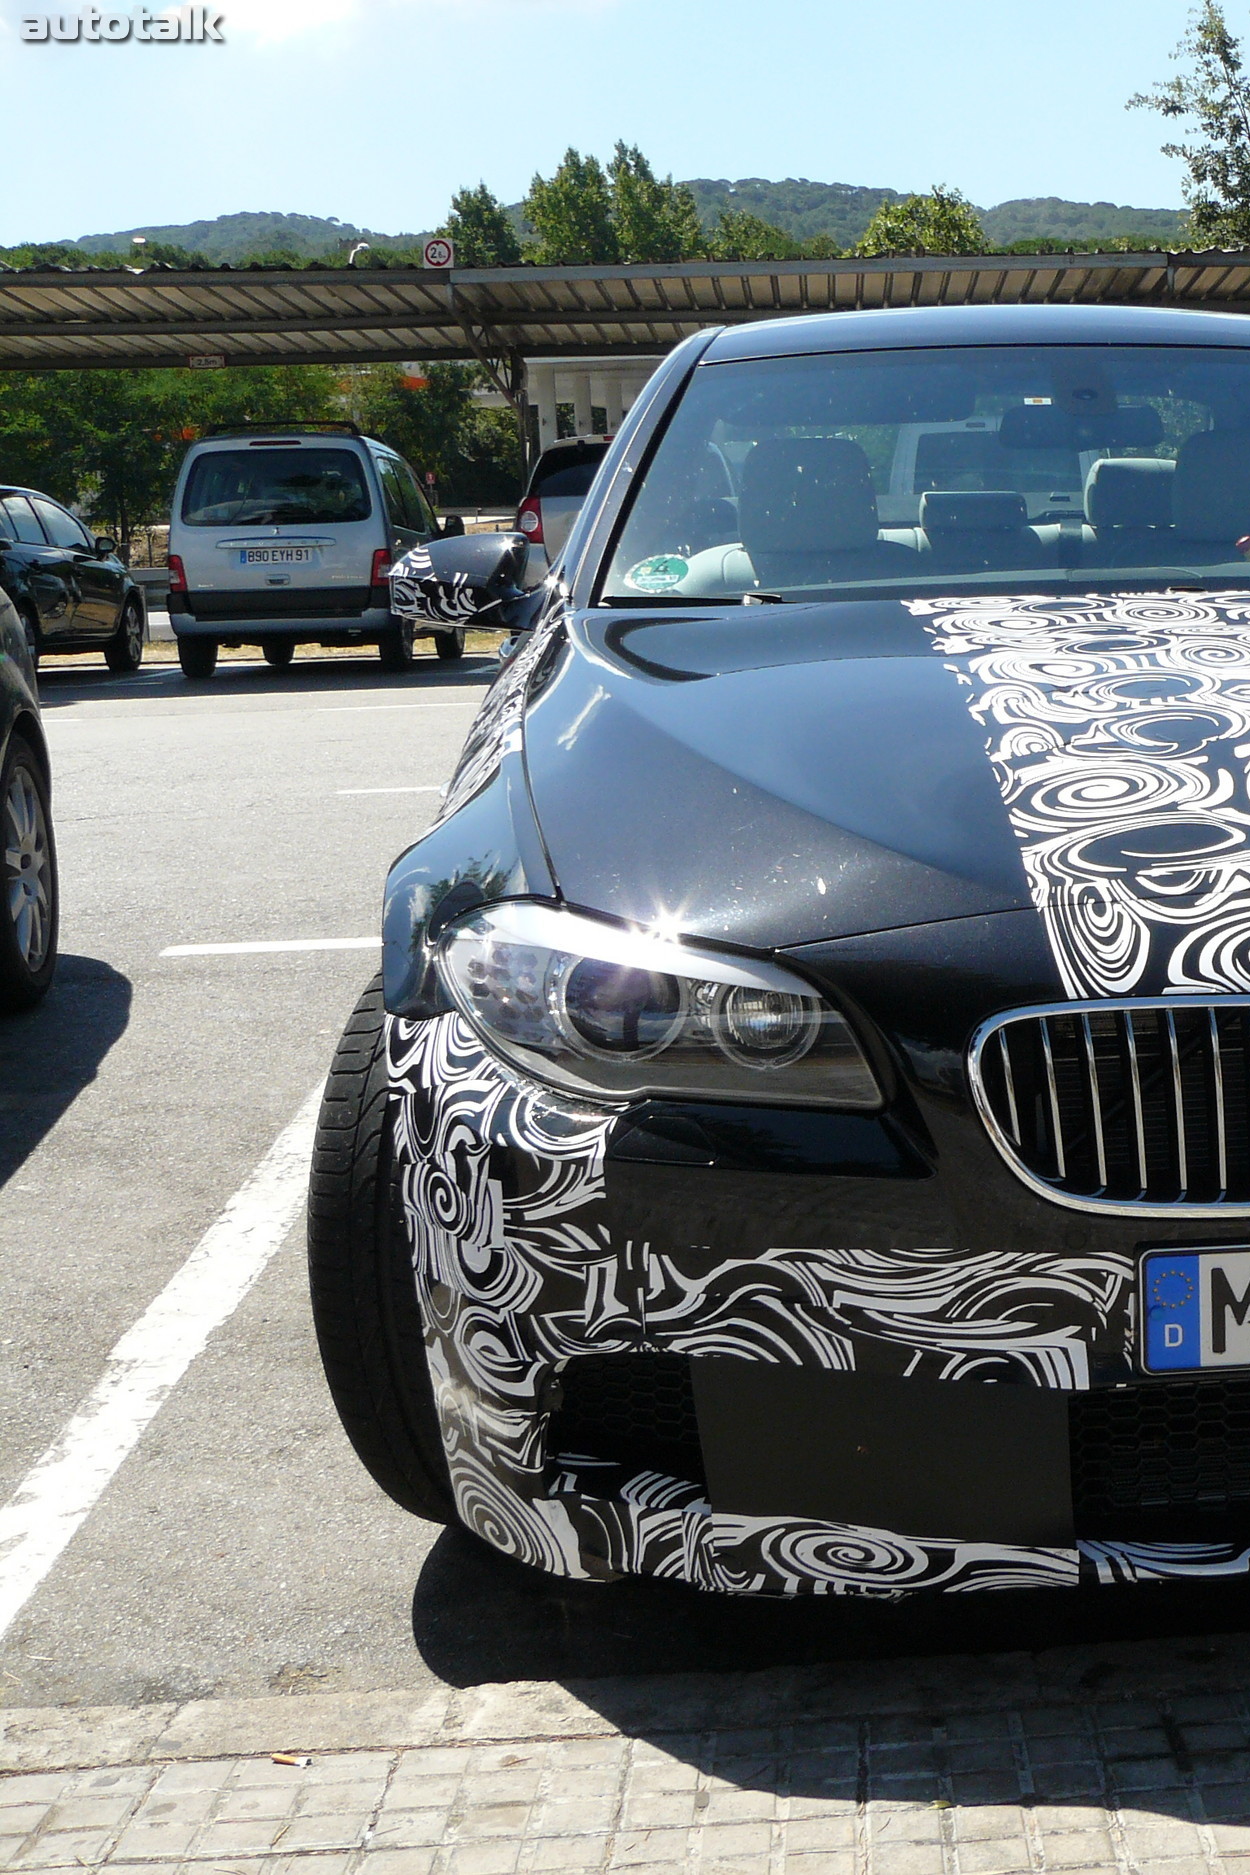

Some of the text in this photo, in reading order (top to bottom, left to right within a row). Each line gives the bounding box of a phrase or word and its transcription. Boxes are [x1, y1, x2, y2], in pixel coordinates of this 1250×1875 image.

[248, 551, 269, 562] 890
[272, 550, 293, 561] EYH
[295, 549, 309, 561] 91
[1164, 1323, 1183, 1348] D
